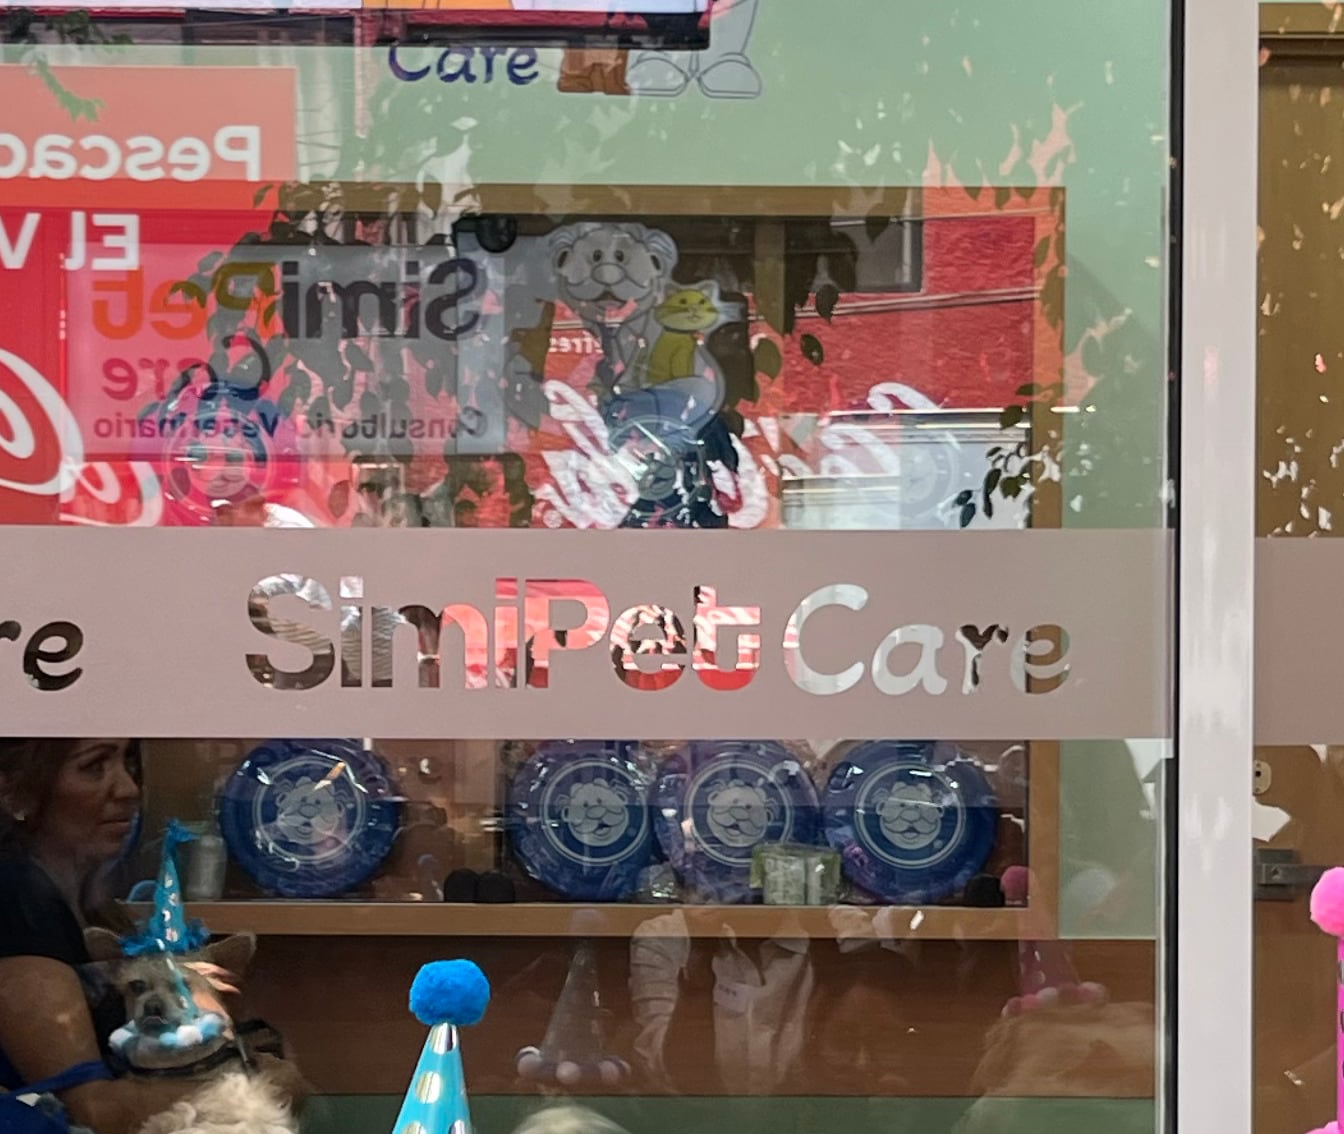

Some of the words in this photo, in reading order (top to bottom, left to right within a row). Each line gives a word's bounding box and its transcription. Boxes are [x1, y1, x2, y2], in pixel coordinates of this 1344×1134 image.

[388, 44, 539, 86] Care
[244, 573, 761, 692] SimiPet
[781, 583, 1072, 696] Care
